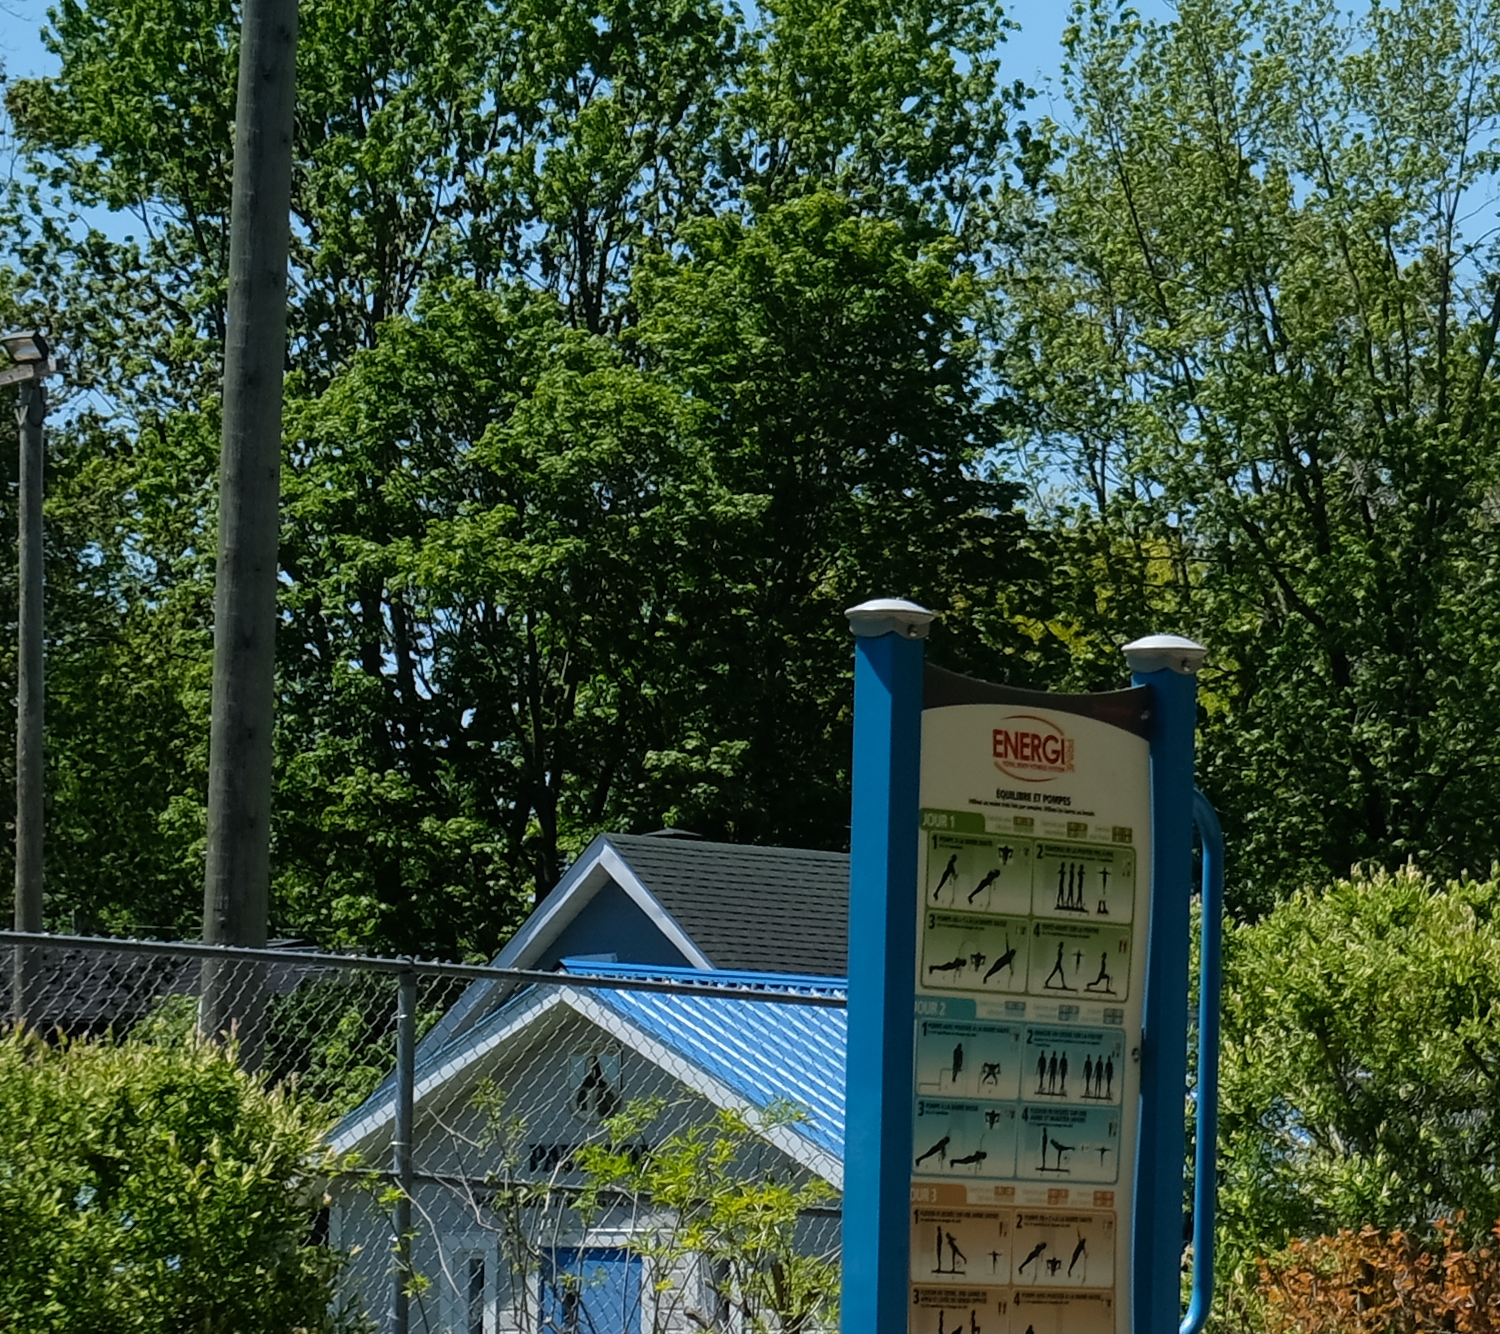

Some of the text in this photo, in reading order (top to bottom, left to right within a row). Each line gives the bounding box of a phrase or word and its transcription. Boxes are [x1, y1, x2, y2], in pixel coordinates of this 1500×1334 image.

[993, 729, 1065, 764] ENERGI
[997, 788, 1071, 806] ÉQUILIBRE ET POMPES
[922, 813, 954, 828] JOUR 1
[932, 836, 937, 849] 1
[1037, 845, 1043, 859] 2
[929, 915, 935, 929] 3
[1034, 923, 1040, 937] 4
[940, 1002, 946, 1016] 2
[922, 1023, 927, 1036] 1
[1027, 1030, 1033, 1043] 2
[918, 1102, 924, 1116] 3
[1022, 1108, 1028, 1121] 4
[931, 1188, 937, 1203] 3
[914, 1211, 919, 1224] 1
[1016, 1215, 1022, 1228] 2
[913, 1290, 919, 1304] 3
[1014, 1292, 1020, 1306] 4
